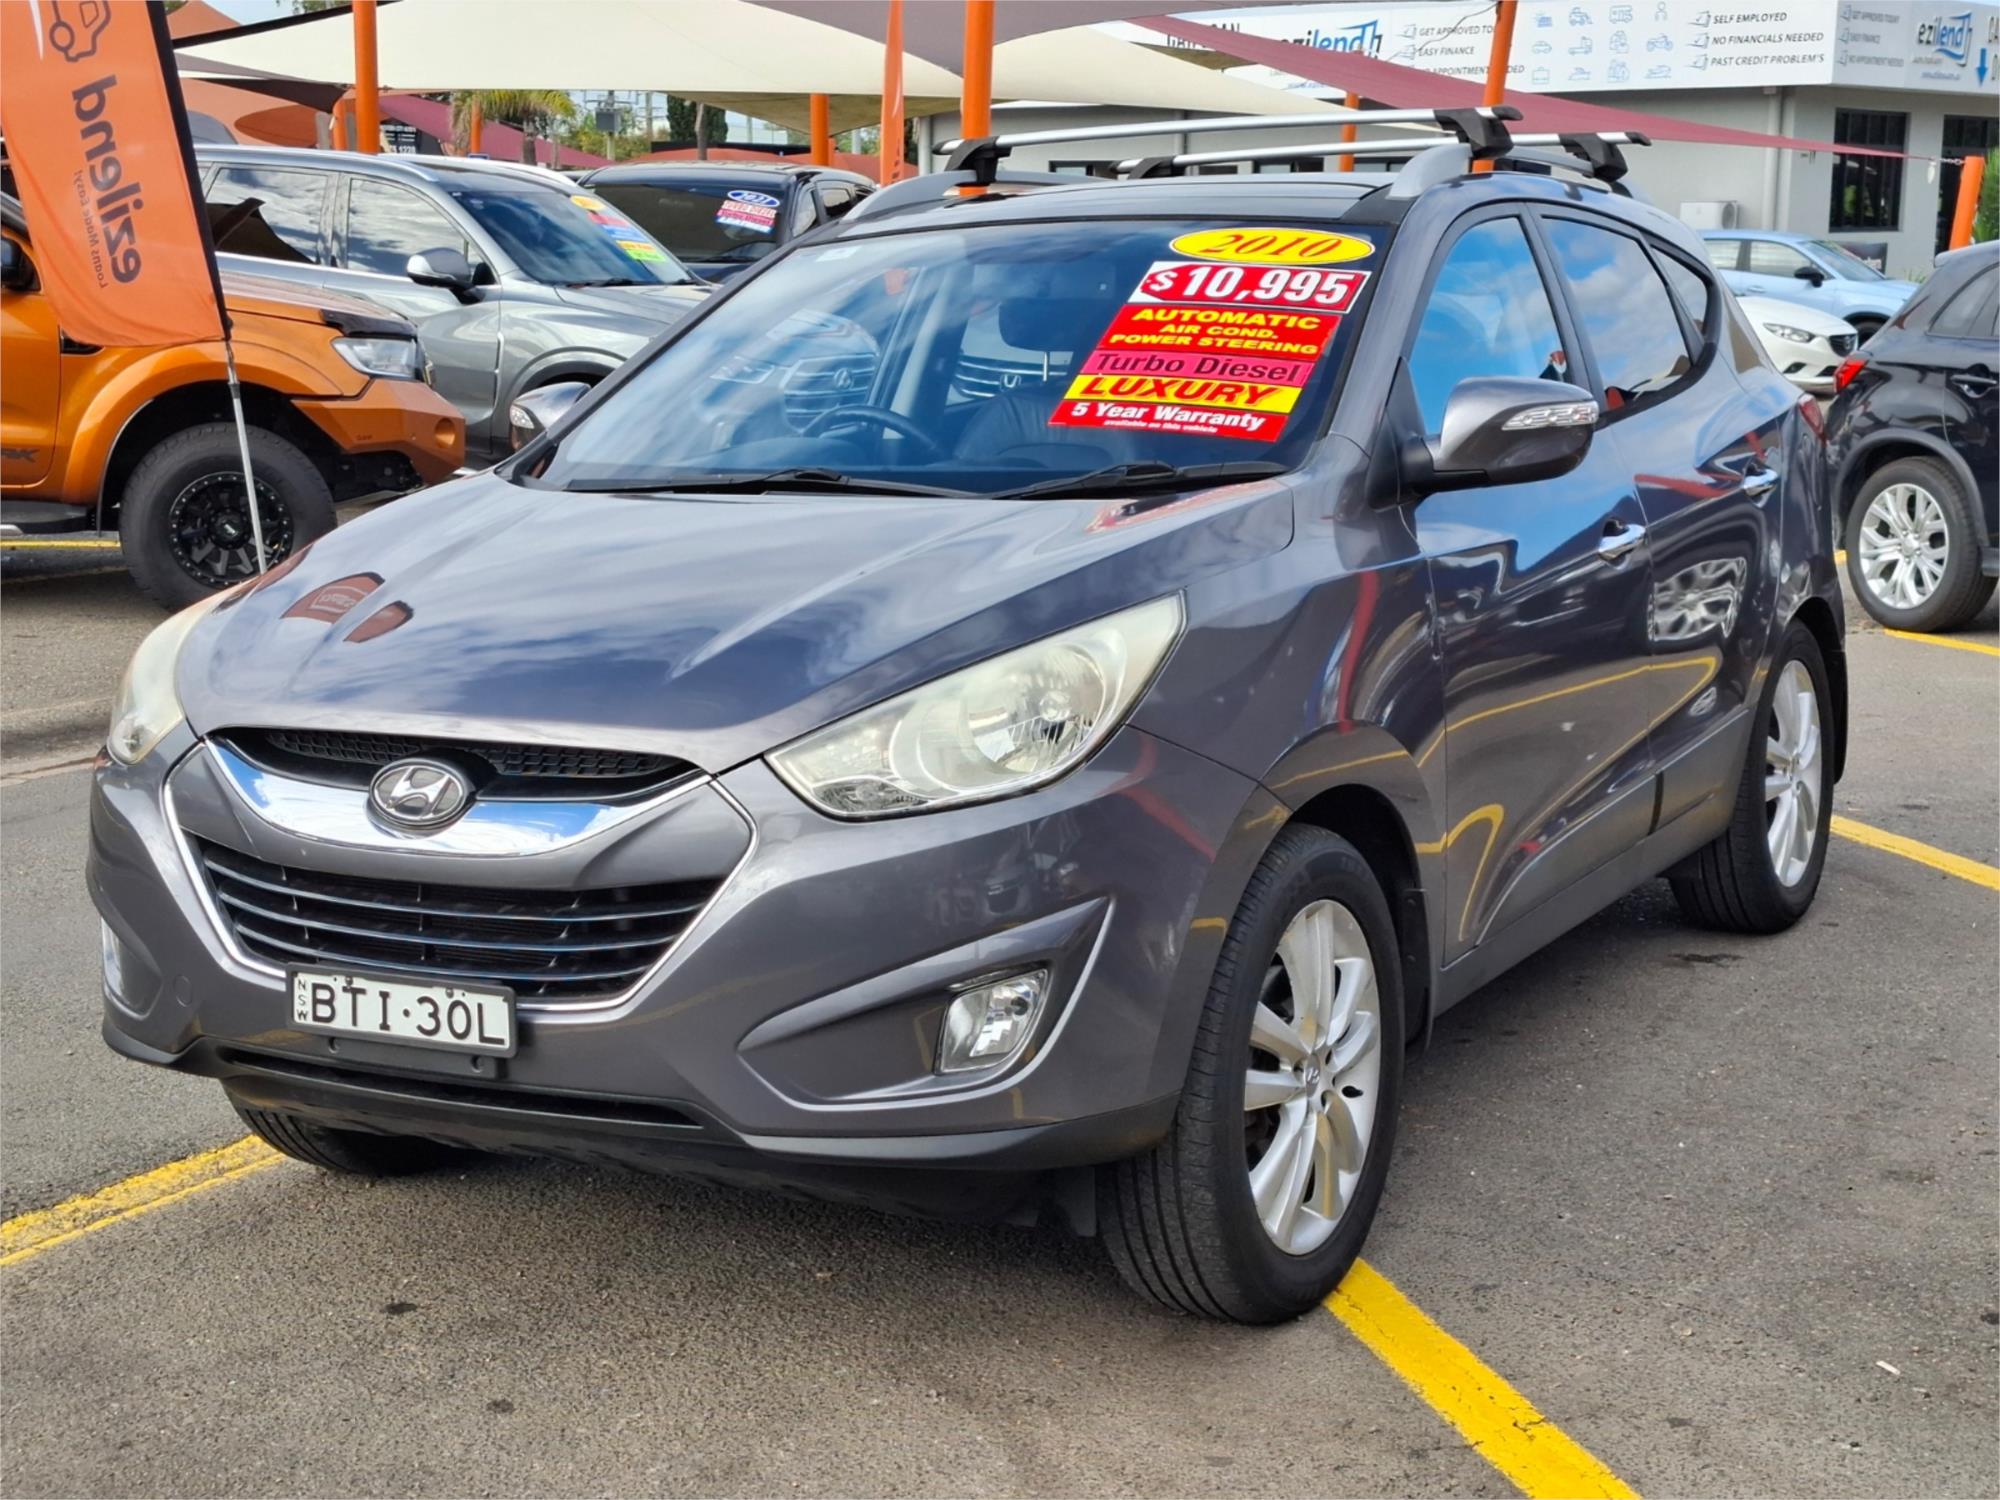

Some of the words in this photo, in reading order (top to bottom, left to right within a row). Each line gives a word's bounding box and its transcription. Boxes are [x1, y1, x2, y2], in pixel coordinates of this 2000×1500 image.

[1713, 14, 1735, 25] SELF
[1736, 12, 1788, 23] EMPLOYED
[1419, 27, 1436, 36] GET
[1436, 25, 1481, 36] APPROVED
[1712, 36, 1727, 45] NO
[1728, 33, 1784, 44] FINANCIALS
[1785, 32, 1824, 42] NEEDED
[1917, 16, 1966, 47] ezilend
[1418, 47, 1438, 57] EASY
[1439, 46, 1475, 56] FINANCE
[1710, 56, 1735, 66] PAST
[1735, 55, 1769, 66] CREDIT
[1769, 53, 1825, 65] PROBLEM'S
[1200, 234, 1343, 257] 2010
[1132, 309, 1321, 330] AUTOMATIC
[1160, 324, 1201, 334] AIR
[1207, 326, 1279, 339] COND.
[1110, 334, 1193, 346] POWER
[1198, 337, 1318, 355] STEERING
[1098, 353, 1185, 373] Turbo
[1194, 356, 1302, 382] Diesel
[1079, 376, 1279, 405] LUXURY
[1071, 402, 1091, 417] 5
[1095, 402, 1149, 419] Year
[1153, 406, 1266, 431] Warranty
[297, 980, 309, 1021] NSW
